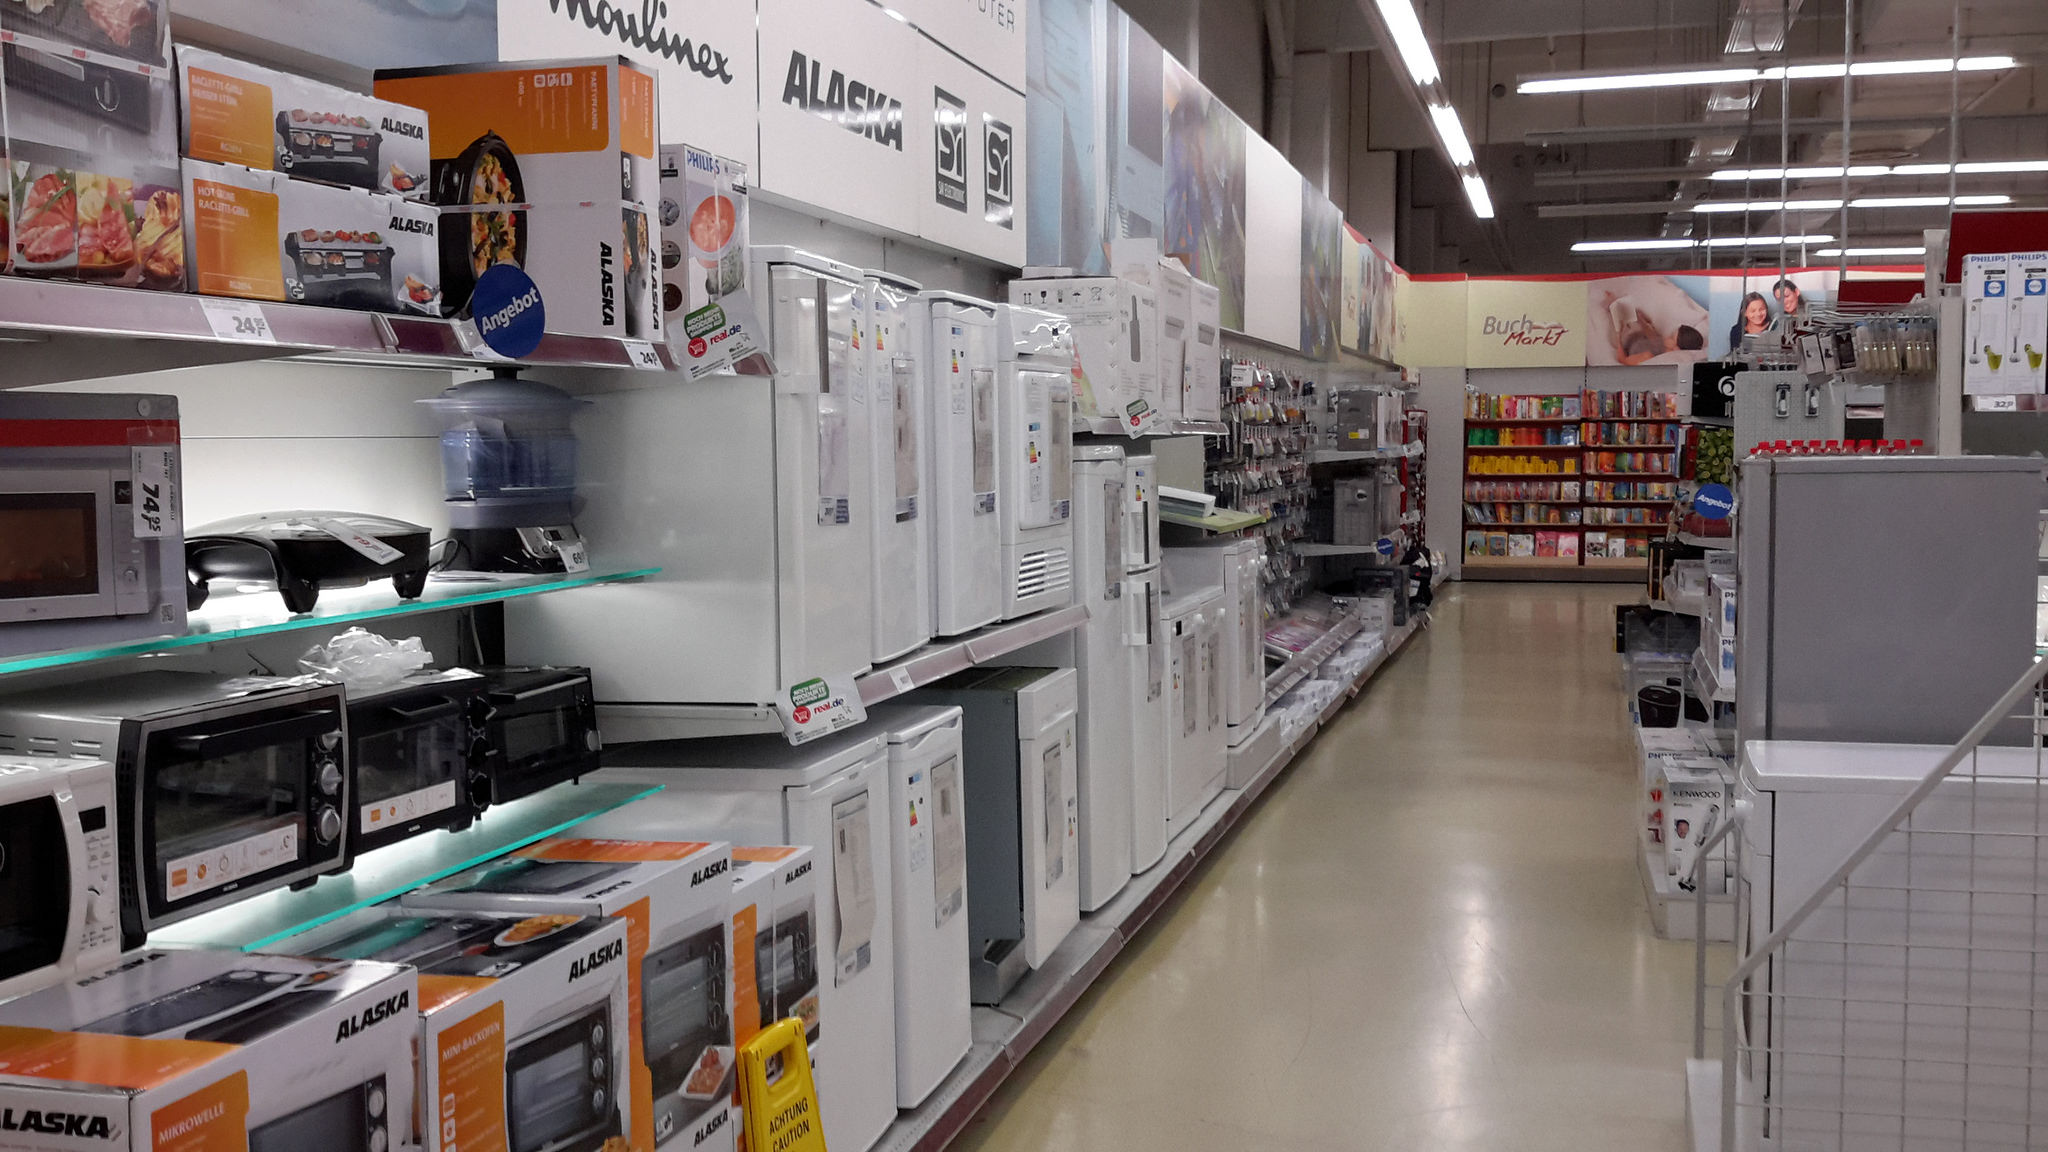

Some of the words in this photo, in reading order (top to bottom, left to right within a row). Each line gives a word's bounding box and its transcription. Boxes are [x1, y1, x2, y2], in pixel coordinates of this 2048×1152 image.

[967, 0, 1015, 33] UTER
[782, 49, 903, 152] ALASKA
[381, 117, 424, 140] ALASKA
[389, 216, 434, 236] ALASKA
[2011, 253, 2048, 261] PHILIPS
[600, 241, 614, 326] ALASKA
[650, 248, 660, 330] ALASKA
[480, 287, 539, 335] Angebot
[1483, 314, 1533, 335] Buch
[710, 324, 742, 345] real.de
[1503, 328, 1569, 346] Markt
[1697, 494, 1732, 510] Angebot
[814, 698, 844, 714] real.de
[690, 858, 729, 888] ALASKA
[785, 860, 812, 885] ALASKA
[568, 938, 623, 983] ALASKA
[335, 989, 409, 1044] ALASKA
[442, 1021, 501, 1063] MINI-BACKOFEN
[0, 1108, 109, 1138] LASKA
[158, 1102, 225, 1145] MIKROWELLE
[694, 1109, 728, 1148] ALASKA
[769, 1097, 809, 1136] ACHTUNG
[772, 1119, 810, 1152] CAUTION
